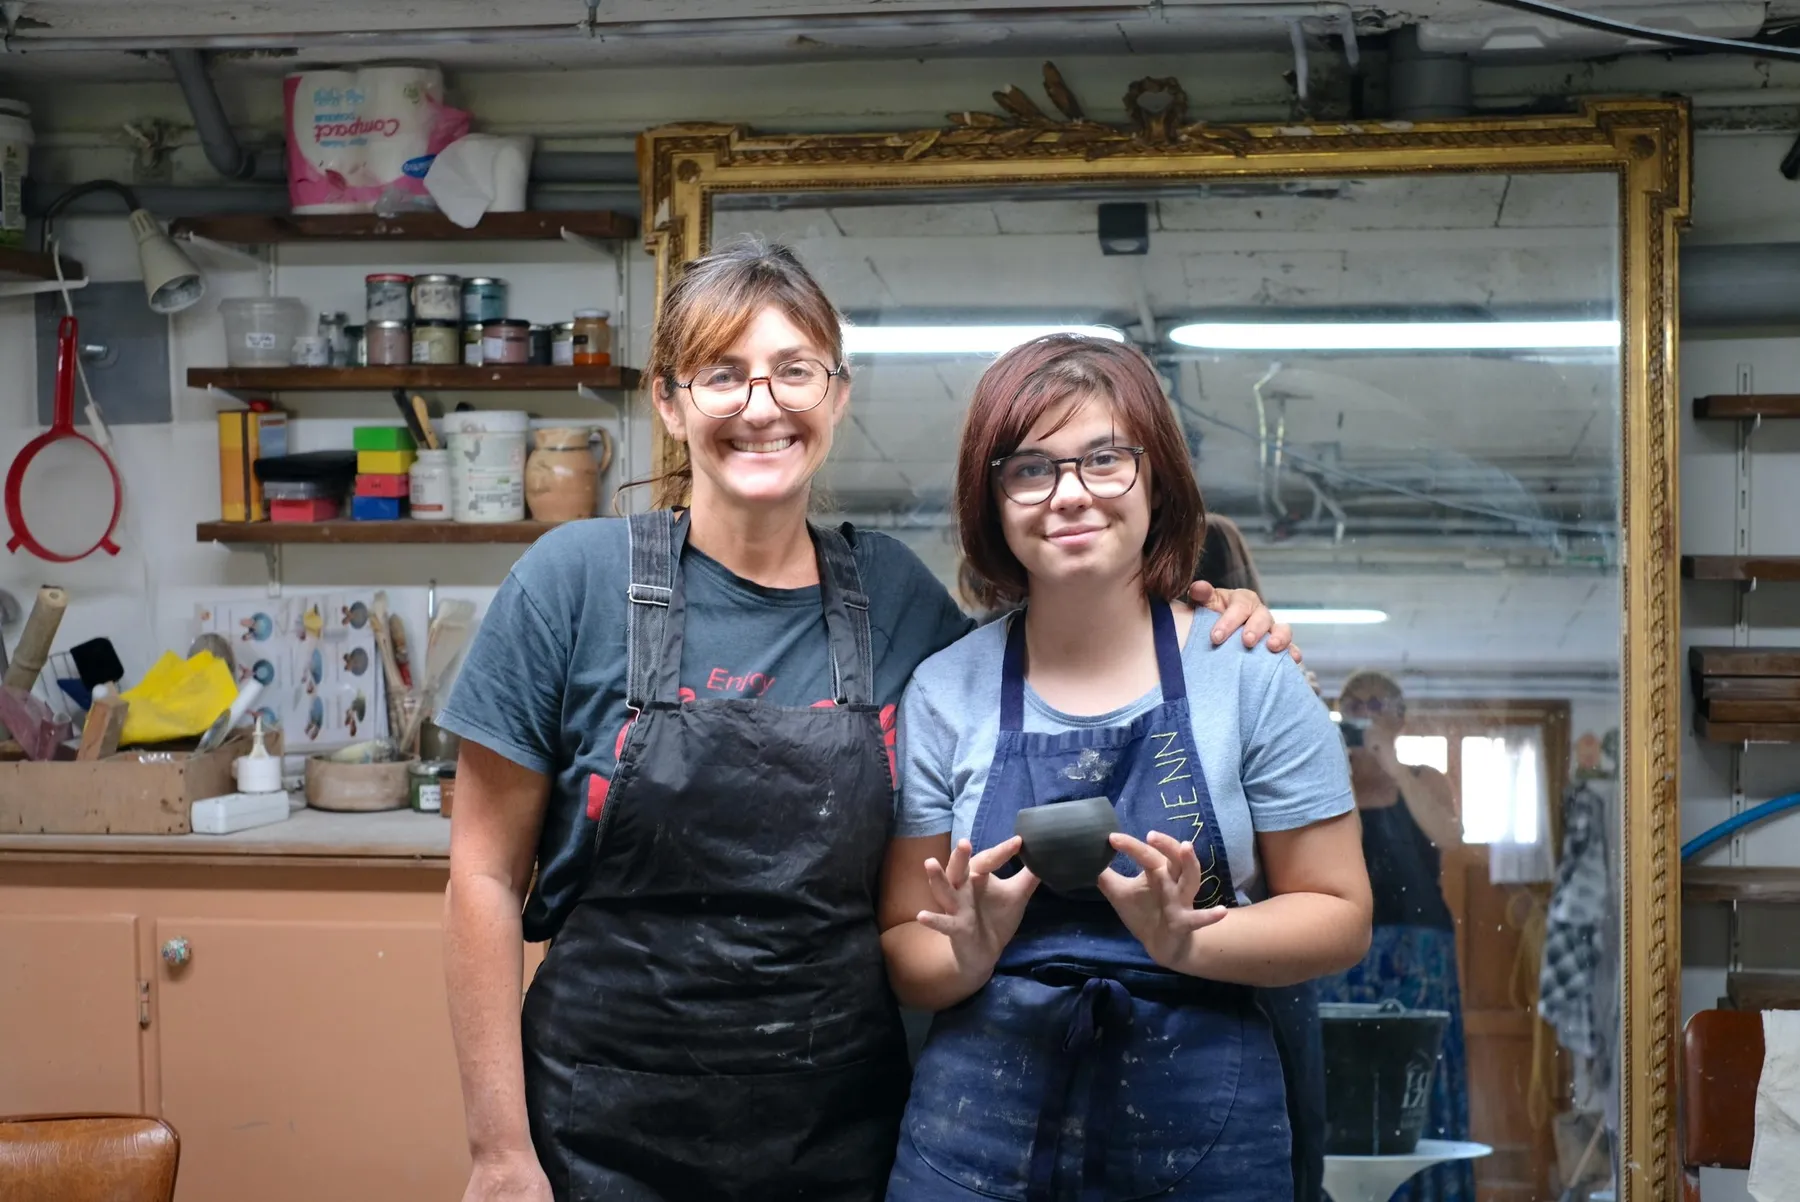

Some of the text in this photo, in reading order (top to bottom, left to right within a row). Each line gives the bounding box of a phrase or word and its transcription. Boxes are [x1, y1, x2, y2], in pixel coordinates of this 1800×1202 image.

[314, 116, 400, 142] Compact
[707, 667, 776, 696] Enjoy
[1151, 731, 1222, 908] OLWENN
